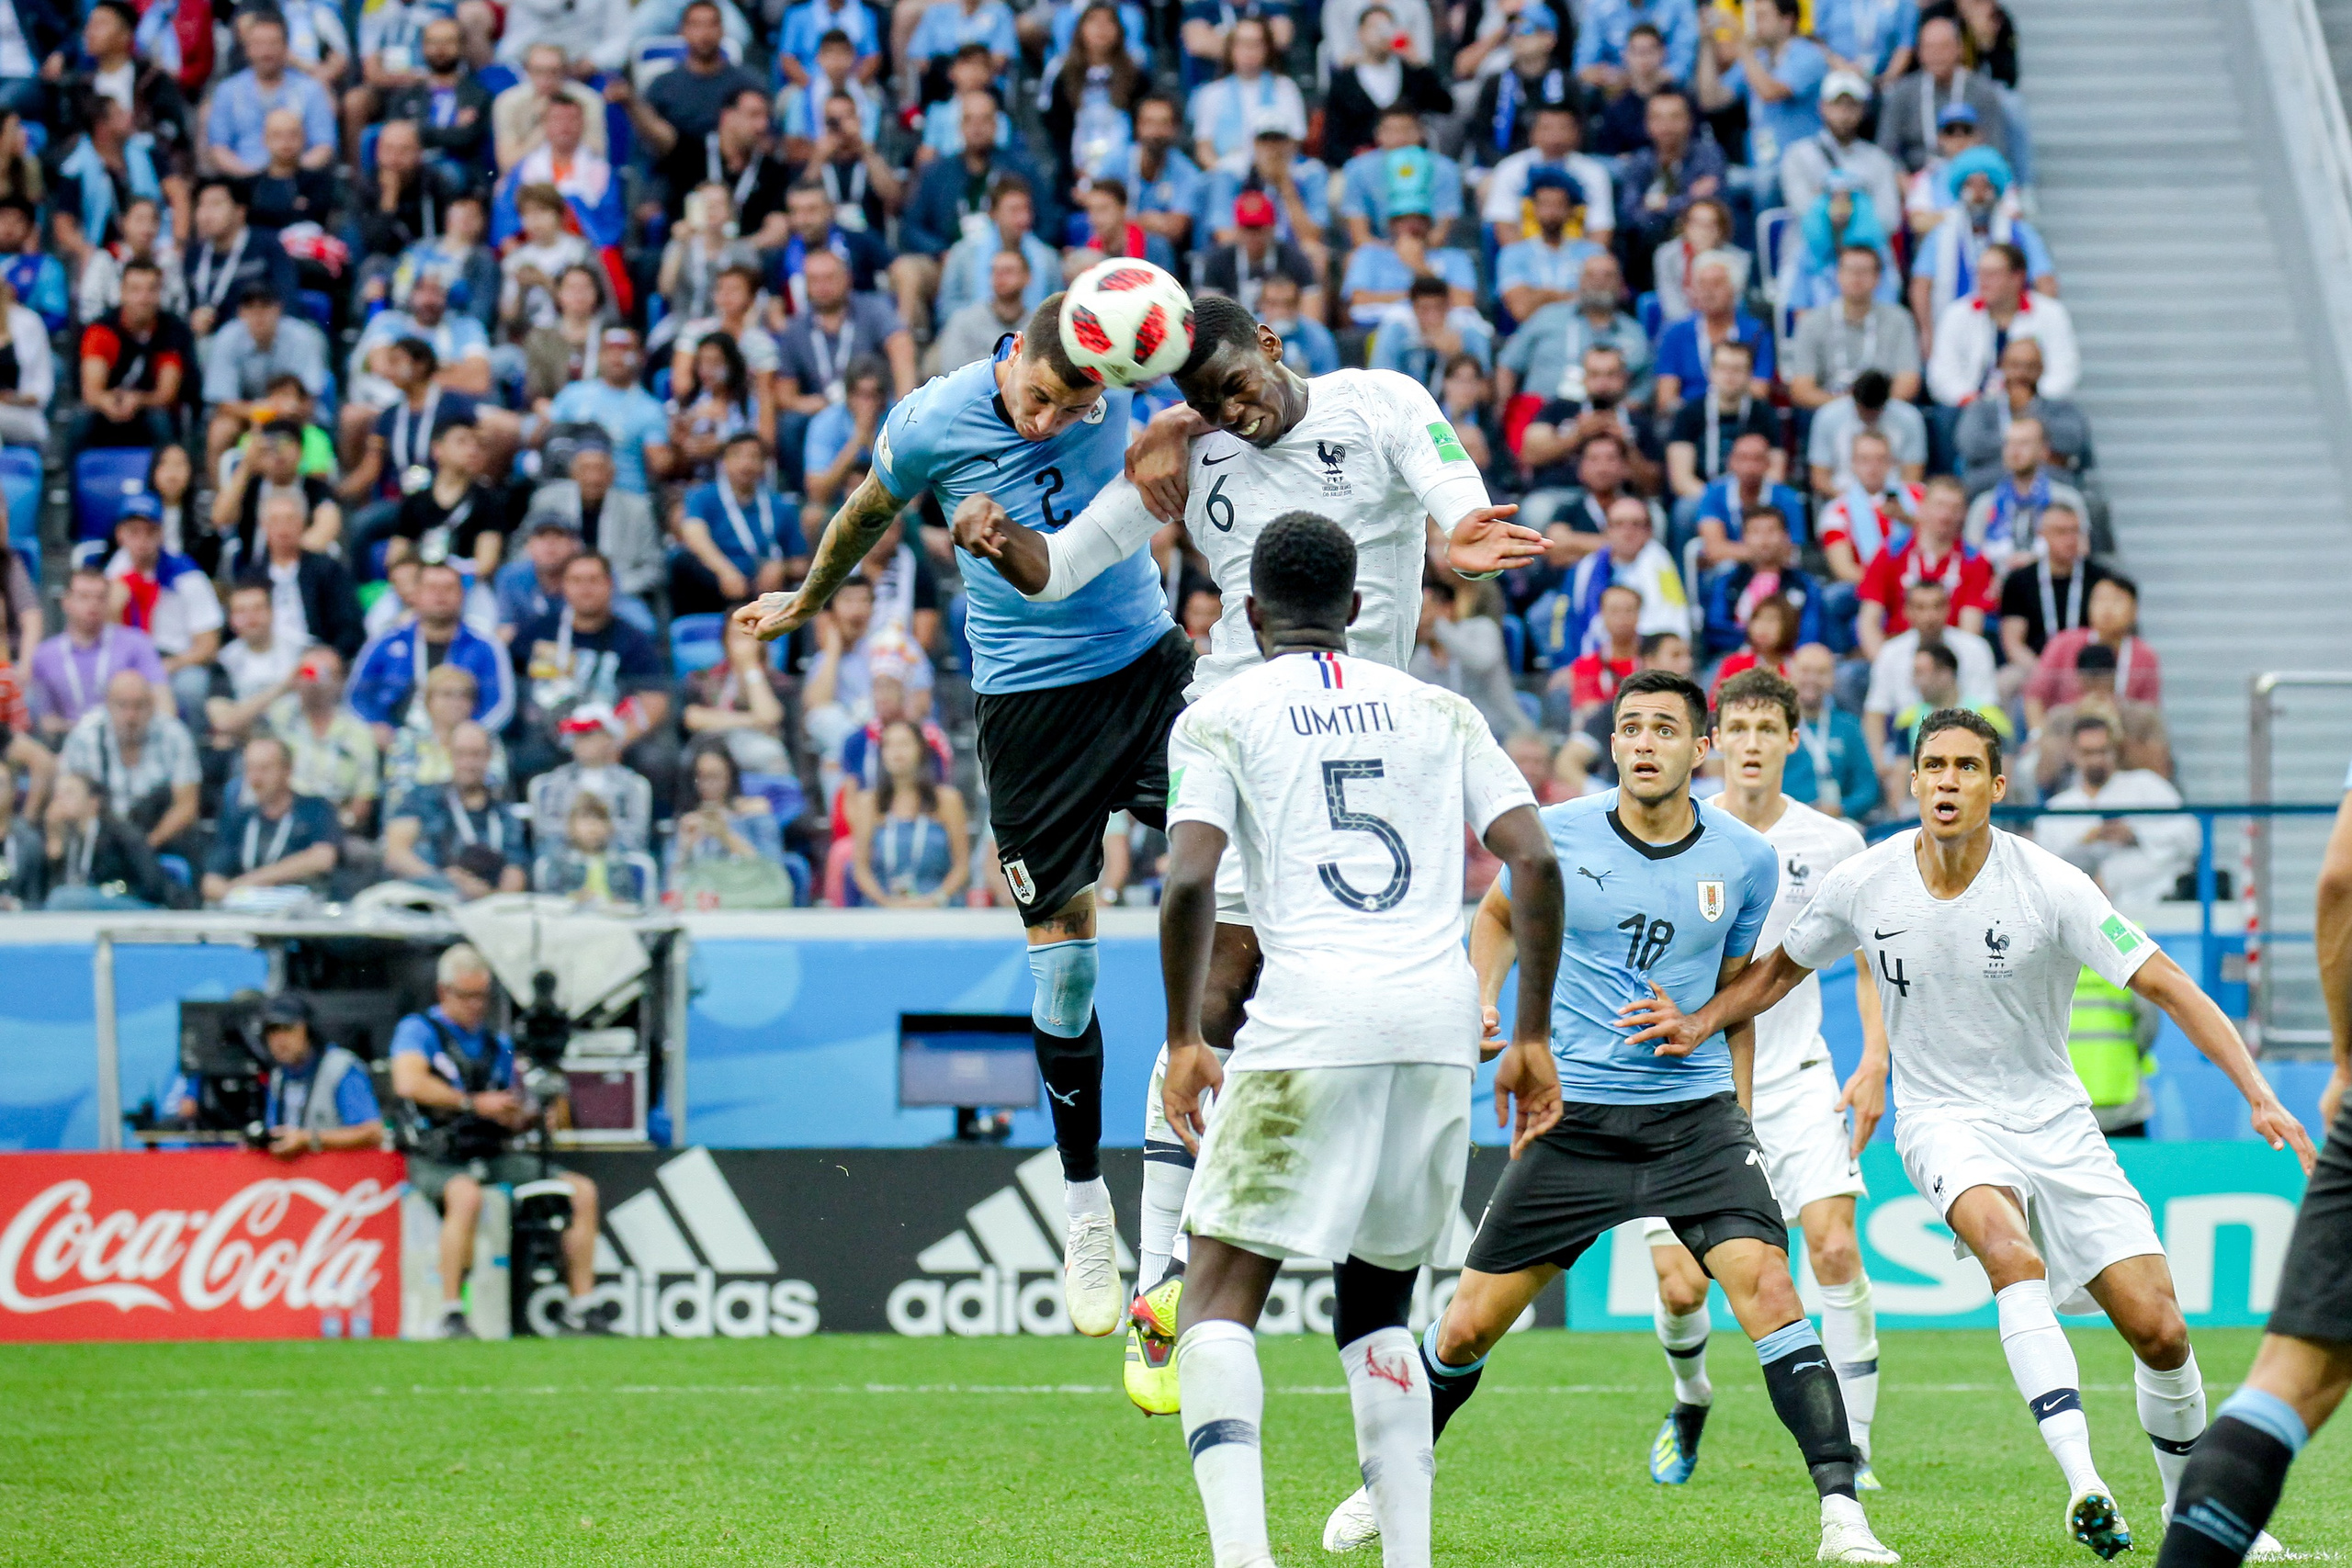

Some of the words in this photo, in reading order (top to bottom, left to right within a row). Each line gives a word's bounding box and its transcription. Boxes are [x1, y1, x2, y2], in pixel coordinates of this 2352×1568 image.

[1035, 467, 1072, 528] 2
[1206, 474, 1234, 532] 6
[1289, 702, 1395, 736] UMTITI
[1317, 758, 1411, 912] 5
[1617, 913, 1675, 971] 18
[1879, 950, 1910, 998] 4
[0, 1179, 401, 1313] Coca-Cola
